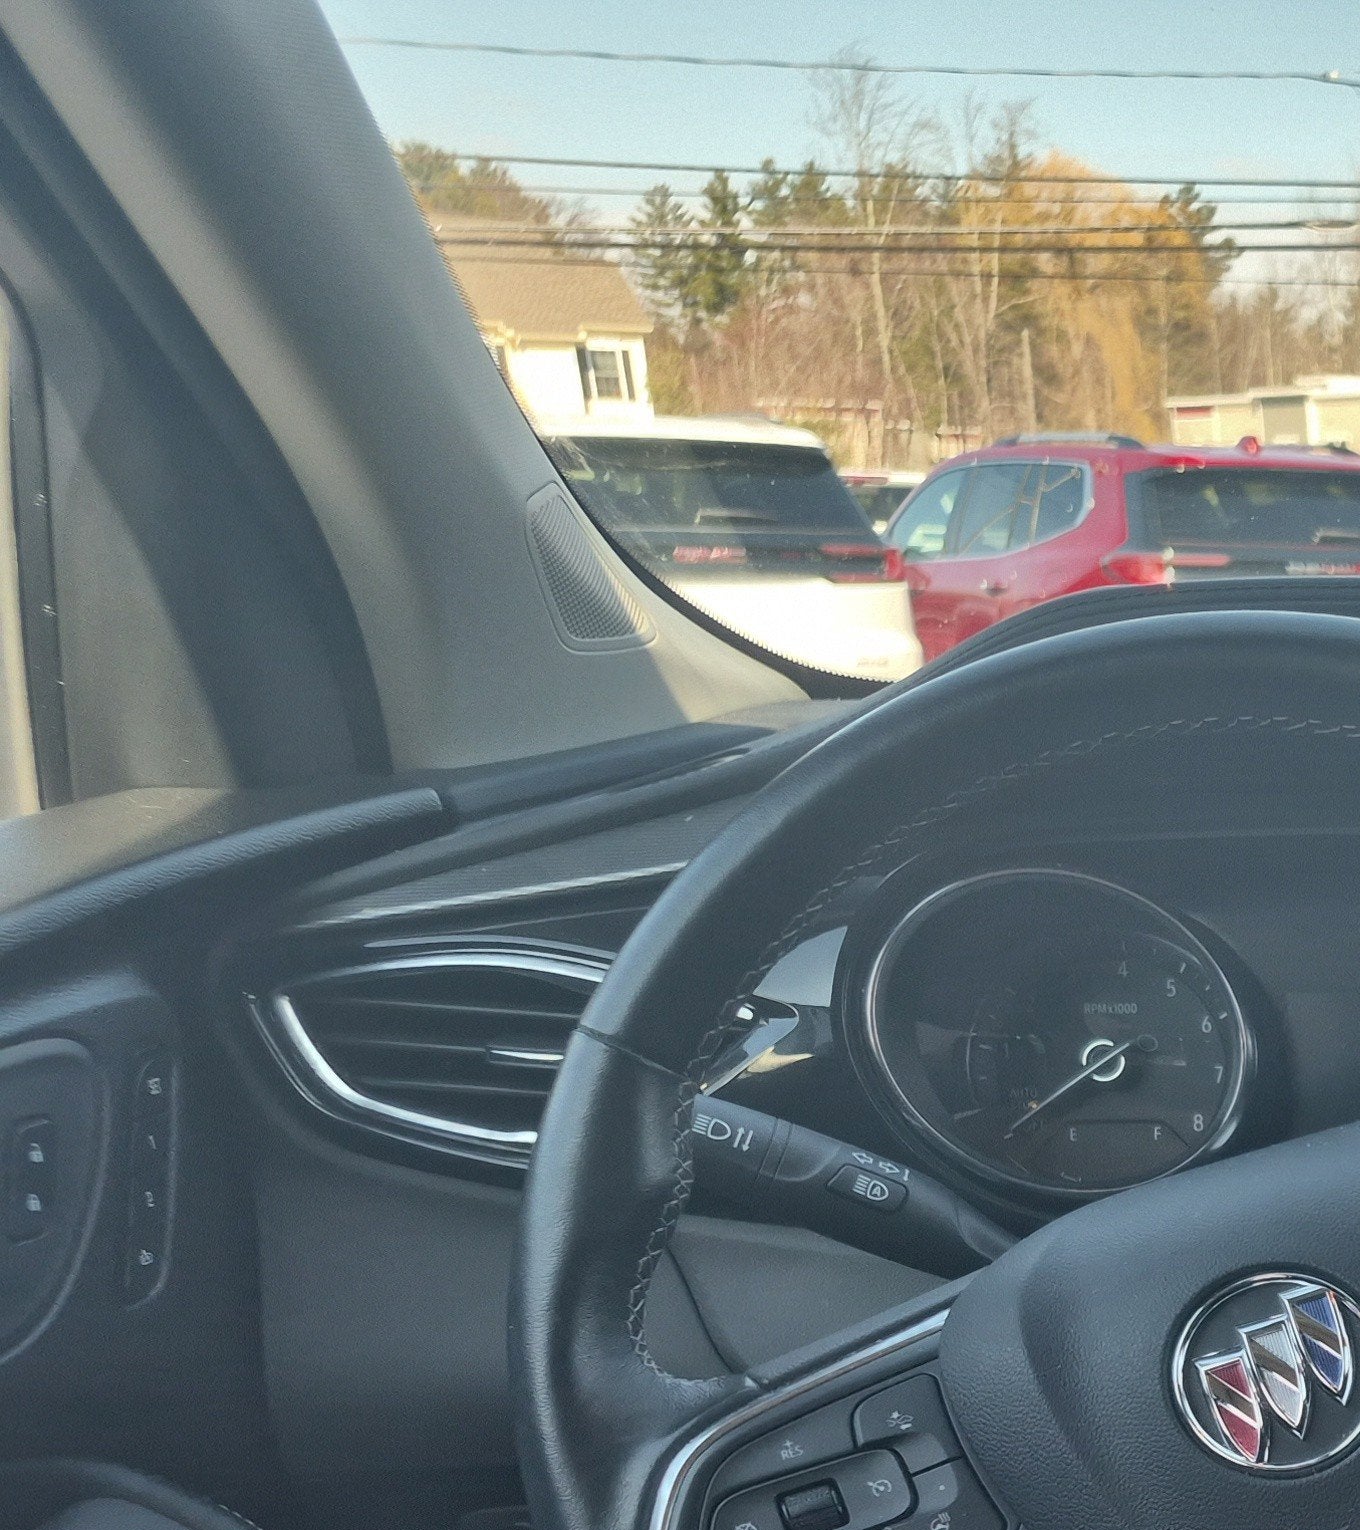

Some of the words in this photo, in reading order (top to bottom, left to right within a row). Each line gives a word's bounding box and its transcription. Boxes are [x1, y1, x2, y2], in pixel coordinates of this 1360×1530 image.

[1117, 961, 1129, 977] 4
[1165, 980, 1178, 998] 5
[1200, 1015, 1213, 1034] 6
[1212, 1065, 1225, 1085] 7
[1191, 1113, 1205, 1133] 8
[1069, 1127, 1079, 1142] E
[1152, 1126, 1163, 1141] F
[781, 1447, 803, 1460] RES
